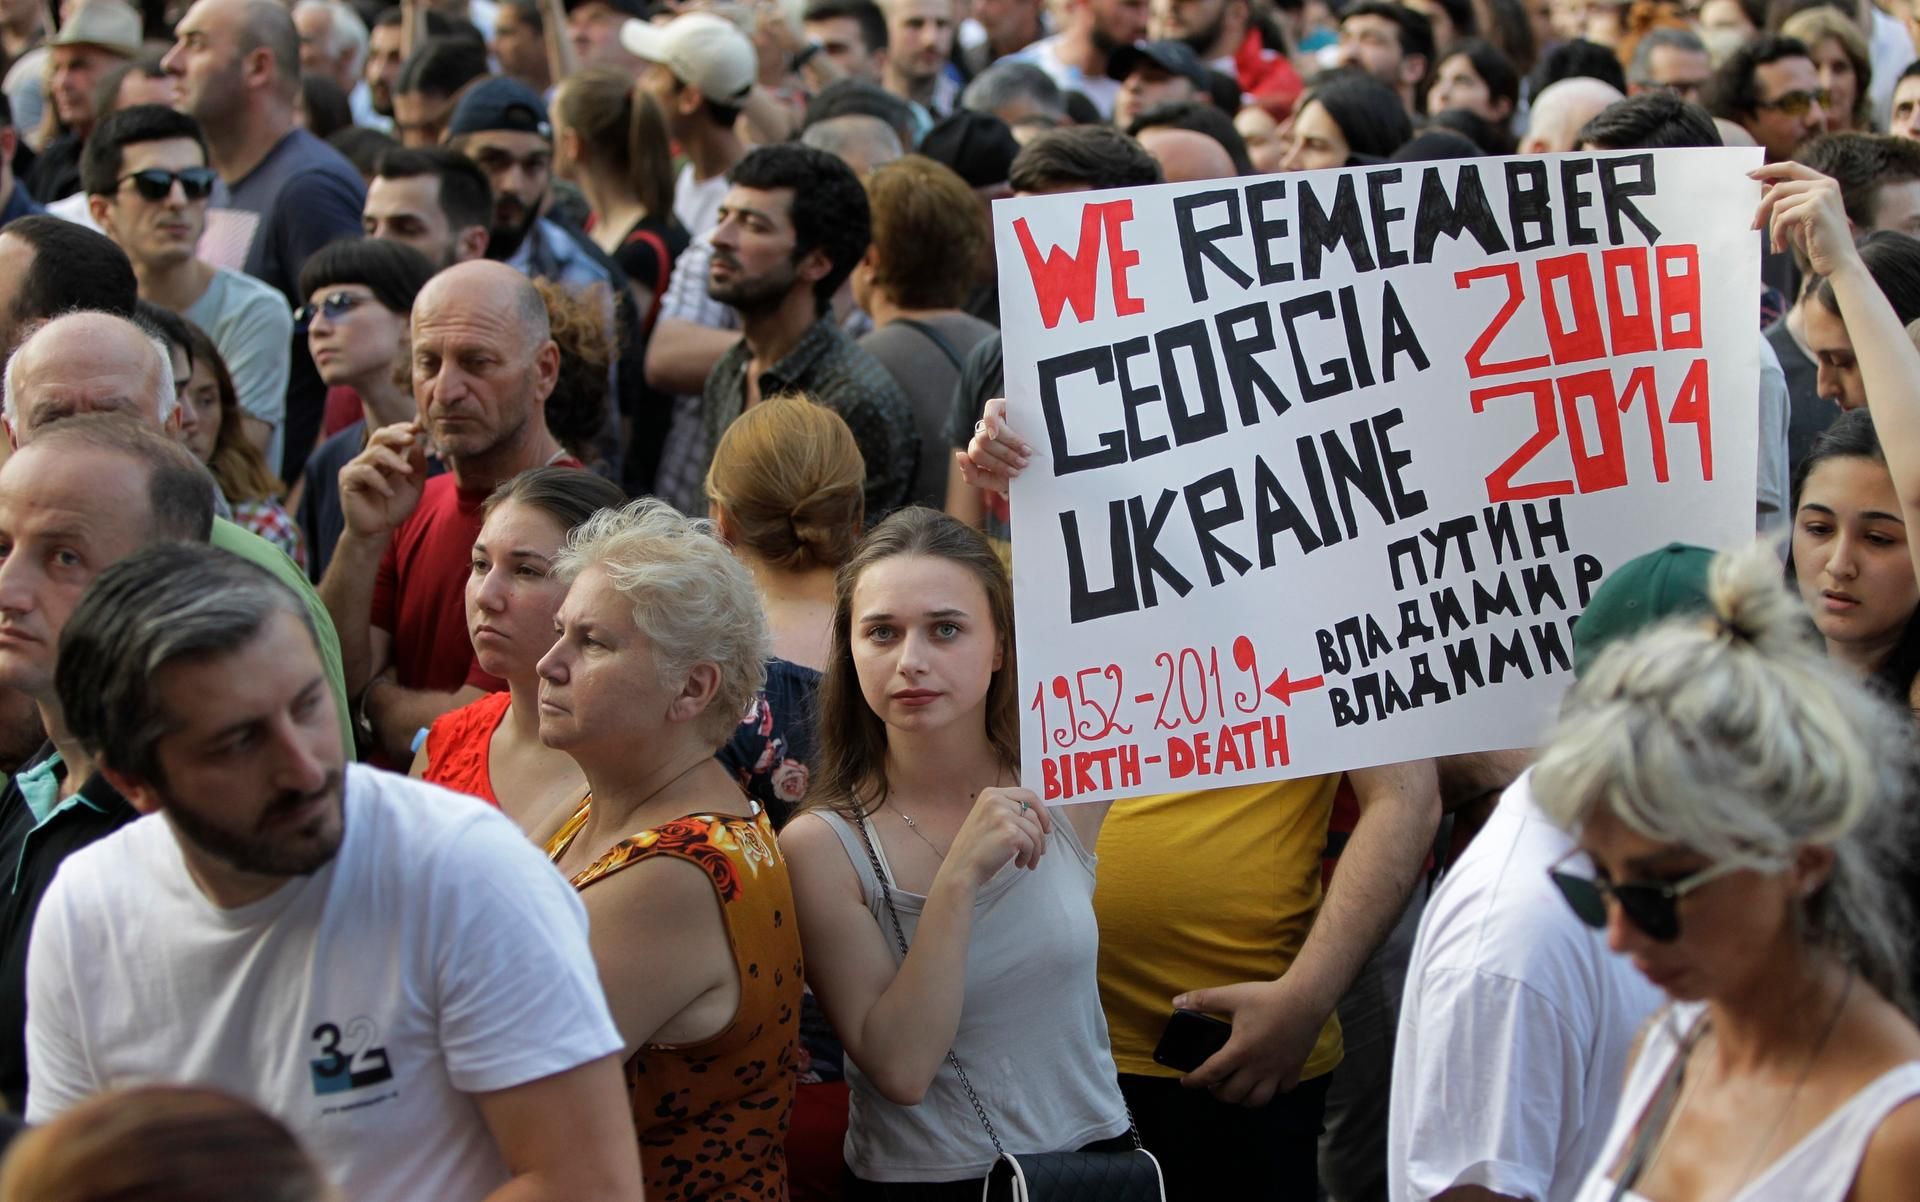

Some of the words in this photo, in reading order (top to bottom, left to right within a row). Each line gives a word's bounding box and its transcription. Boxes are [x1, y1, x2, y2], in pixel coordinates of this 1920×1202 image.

[1012, 199, 1145, 329] WE
[1173, 153, 1662, 302] REMEMBER
[1036, 280, 1431, 477] GEORGIA
[1454, 244, 1704, 379] 2008
[1058, 408, 1429, 624] UKRAINE
[1469, 358, 1714, 503] 2014
[1386, 497, 1571, 592] ПУТИН
[1315, 553, 1604, 675] ВЛАДИМИР
[1328, 614, 1582, 728] ВЛАДИМИ
[1031, 635, 1262, 754] 1952-2019
[311, 1016, 386, 1079] 32
